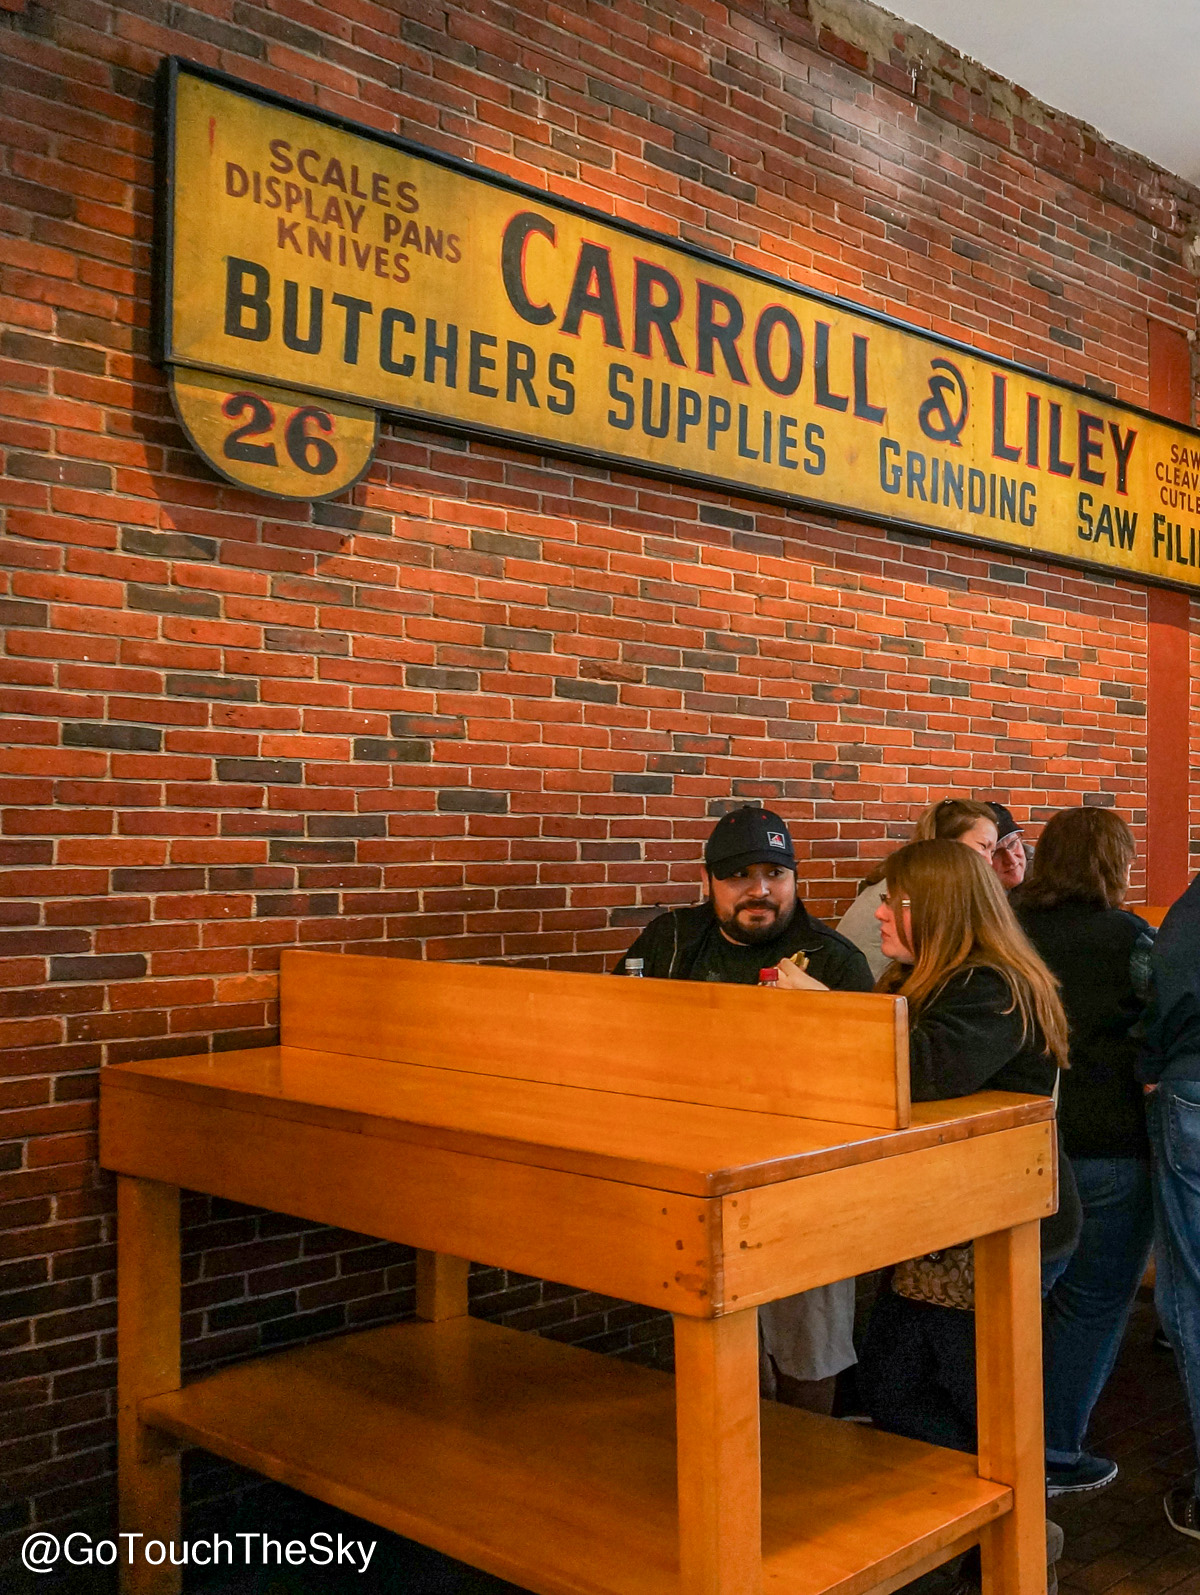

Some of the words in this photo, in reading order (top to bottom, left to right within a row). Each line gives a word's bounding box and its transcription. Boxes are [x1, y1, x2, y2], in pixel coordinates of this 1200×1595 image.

[226, 163, 363, 233] DISPLAY
[384, 212, 462, 263] PANS
[269, 139, 420, 214] SCALES
[277, 217, 412, 284] KNIVES
[500, 209, 887, 426] CARROLL
[917, 357, 971, 447] &
[991, 372, 1138, 496] LILEY
[221, 391, 339, 476] 26
[223, 255, 576, 416] BUTCHERS
[607, 363, 827, 476] SUPPLIES
[879, 437, 1037, 527] GRINDING
[1077, 492, 1138, 551] SAW
